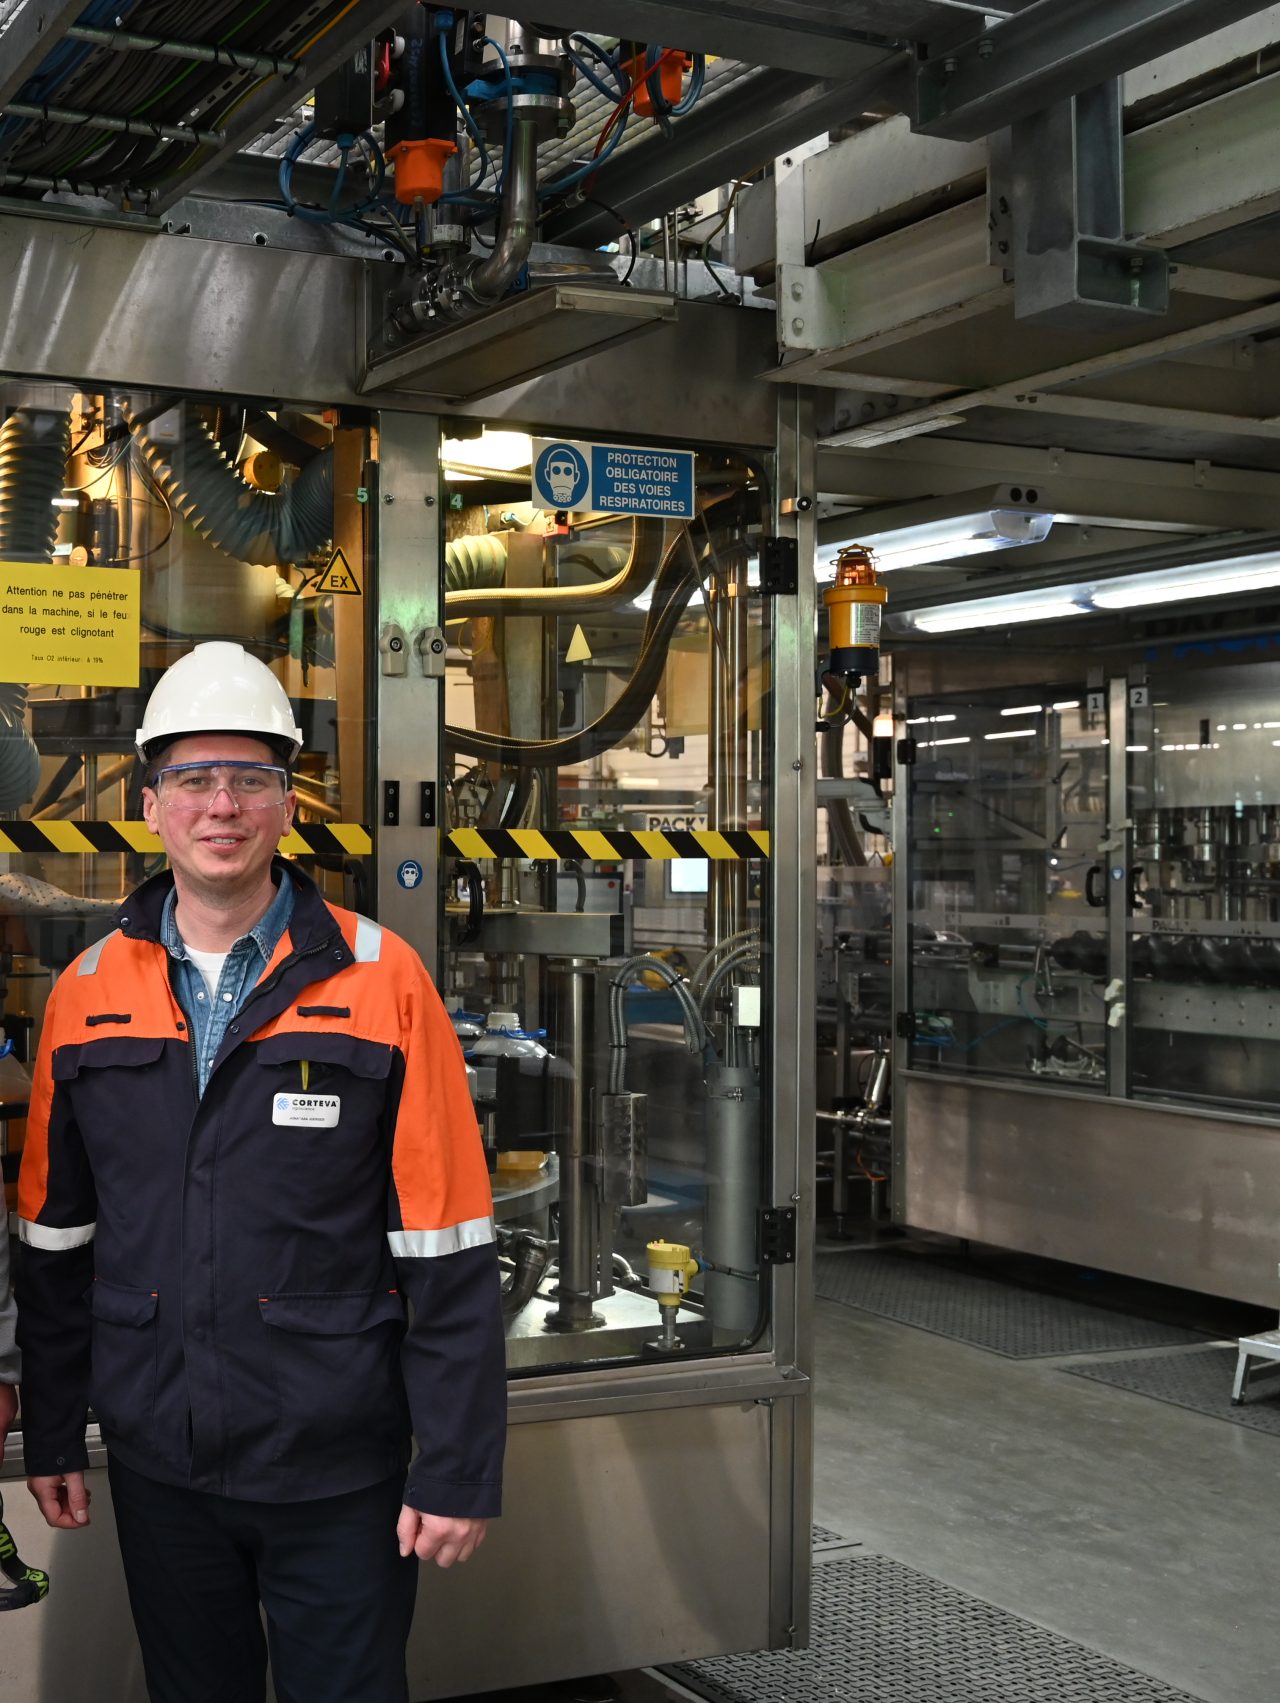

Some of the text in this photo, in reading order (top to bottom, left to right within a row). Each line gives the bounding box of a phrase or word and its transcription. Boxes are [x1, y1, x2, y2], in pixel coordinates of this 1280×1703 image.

[607, 452, 677, 468] PROTECTION
[606, 466, 678, 482] OBLIGATOIRE
[356, 488, 368, 503] 5
[614, 482, 671, 496] DES VOIES
[451, 493, 462, 509] 4
[600, 496, 685, 512] RESPIRATOIRES
[330, 575, 348, 588] EX
[6, 586, 128, 601] Attention ne pas pénétrer
[2, 605, 127, 620] dans la machine, si le feu
[20, 626, 114, 638] rouge est clignotant
[1092, 697, 1098, 709] 1
[1134, 692, 1143, 704] 2
[292, 1099, 337, 1107] CORTEVA
[20, 1569, 49, 1600] vex
